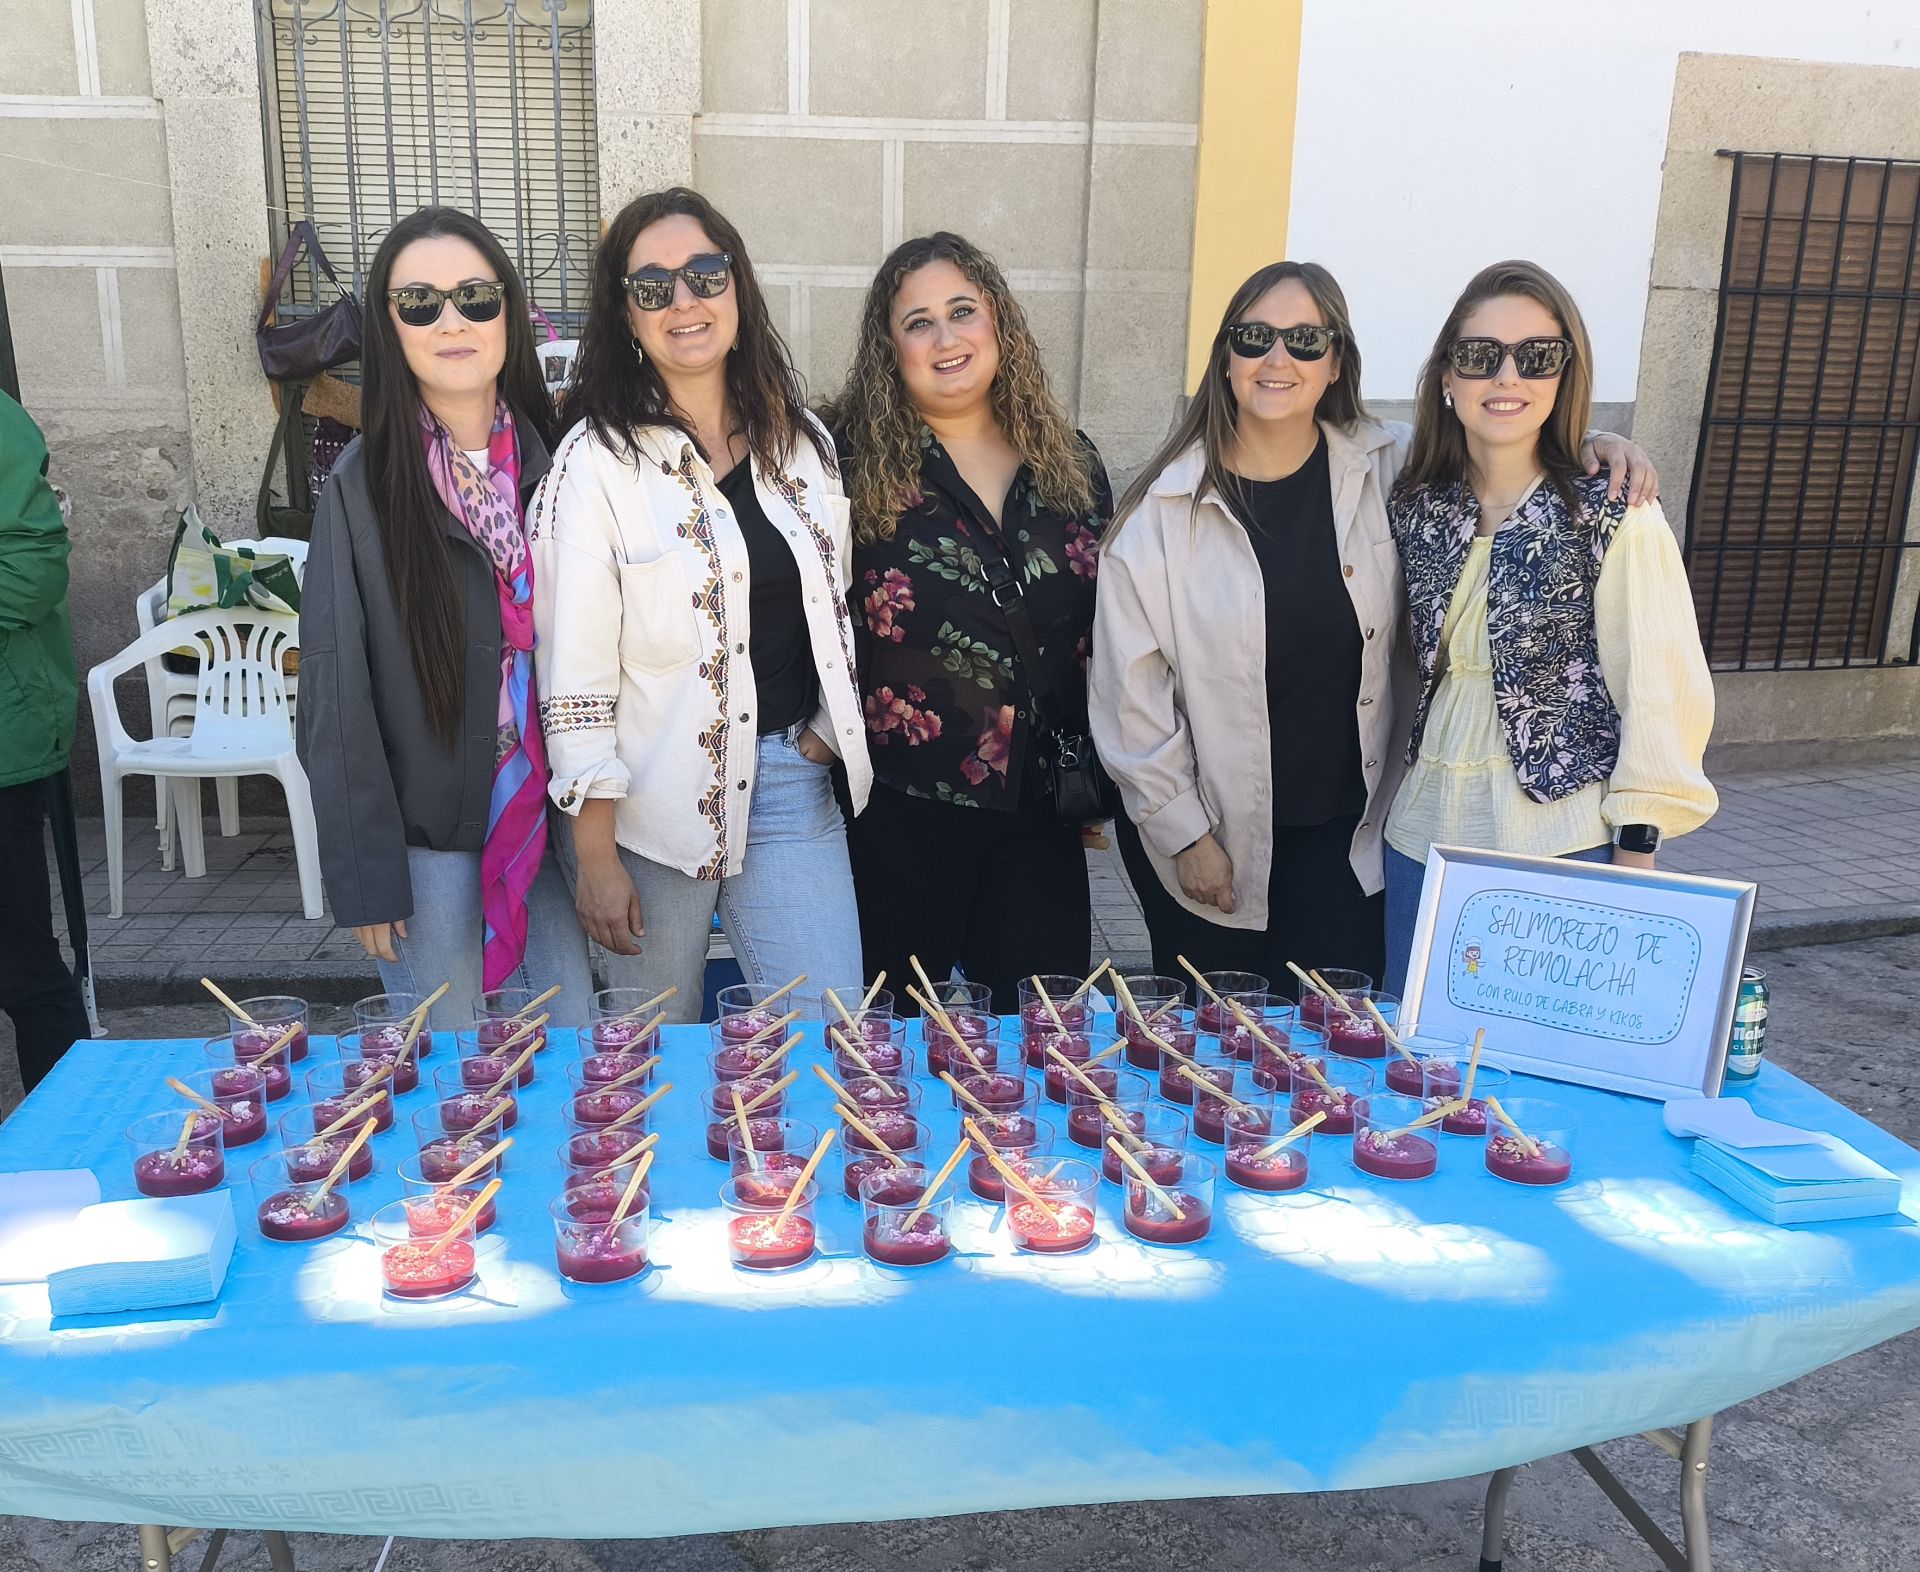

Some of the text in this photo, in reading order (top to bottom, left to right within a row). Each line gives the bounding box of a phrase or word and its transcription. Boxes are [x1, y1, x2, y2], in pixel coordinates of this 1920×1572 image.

[1488, 904, 1668, 964] SALMOREJO DE
[1503, 945, 1637, 996] REMOLACHA
[1504, 988, 1532, 1006] RULO
[1535, 995, 1550, 1010] DE
[1552, 998, 1594, 1018] CABRA
[1609, 1009, 1644, 1029] KIKOS
